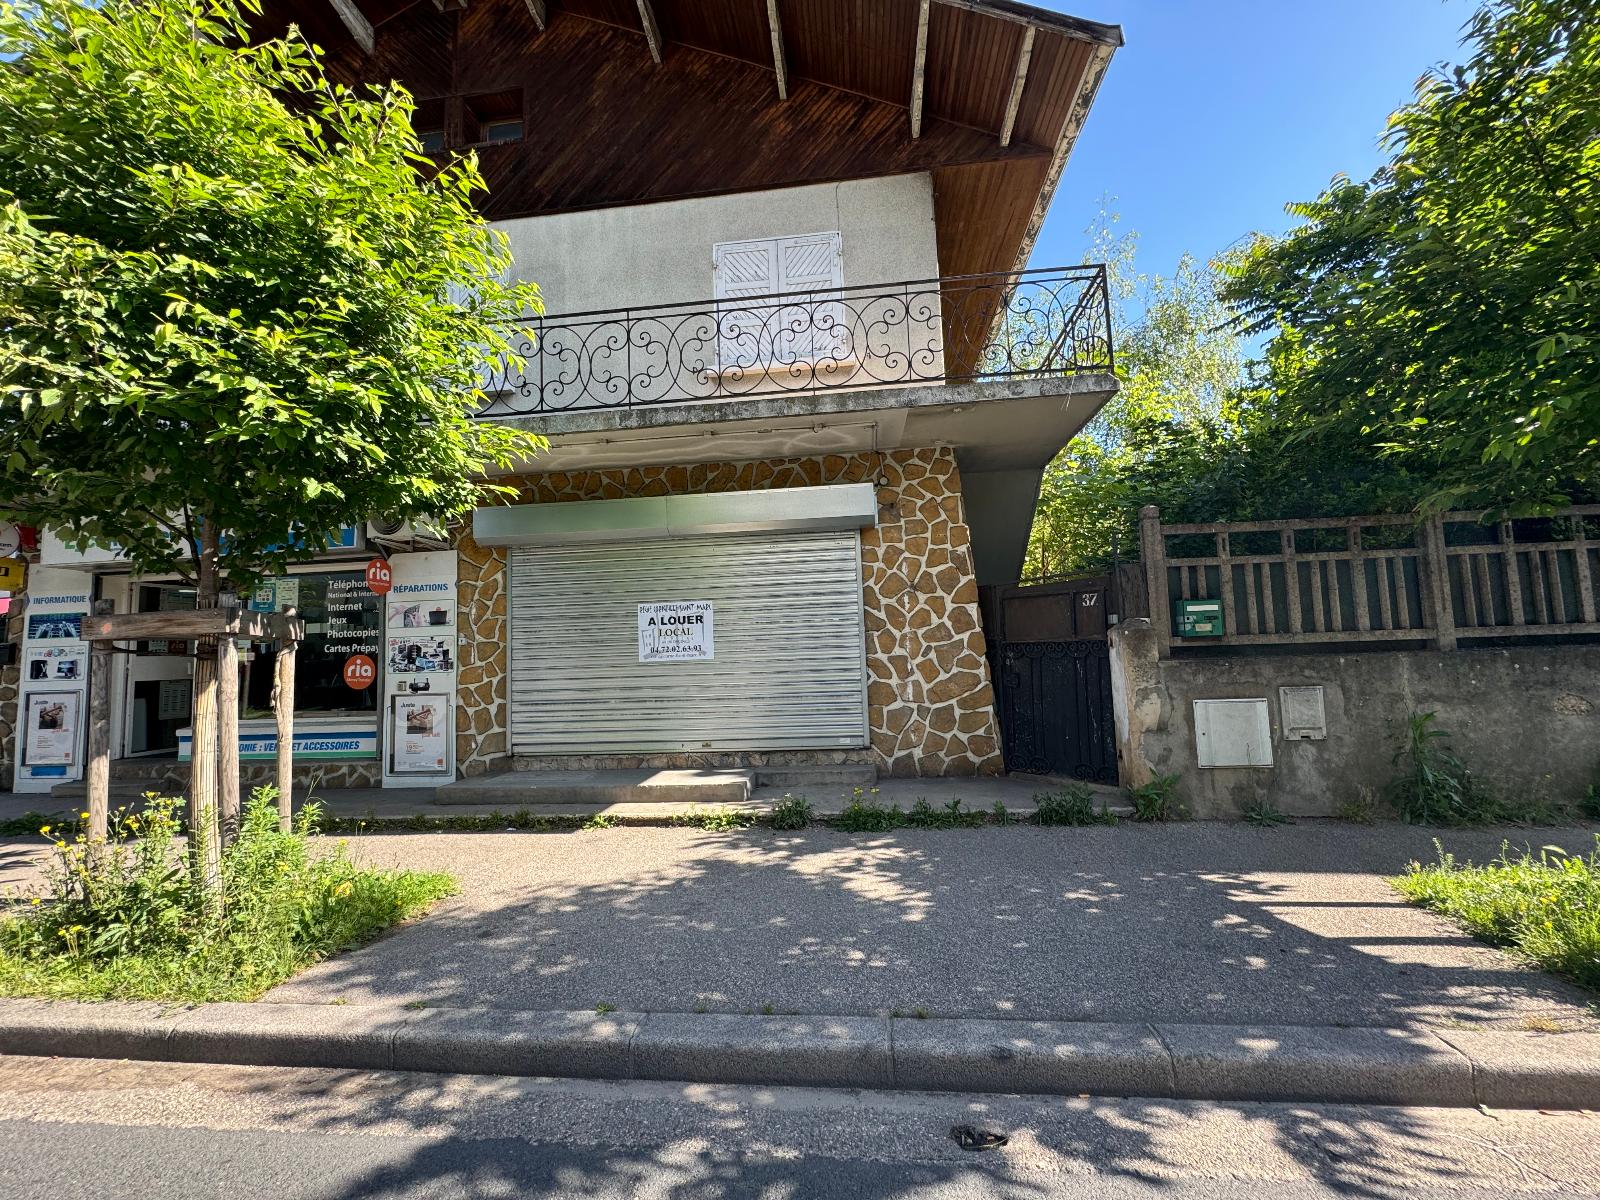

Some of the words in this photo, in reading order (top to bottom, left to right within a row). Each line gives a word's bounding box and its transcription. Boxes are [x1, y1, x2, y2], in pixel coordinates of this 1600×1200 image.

[370, 562, 389, 581] ria
[328, 579, 368, 590] Téléphon
[394, 583, 448, 593] RÉPARATIONS
[33, 594, 87, 605] INFORMATIQUE
[1082, 593, 1097, 607] 37
[328, 602, 362, 611] Internet
[327, 616, 347, 624] Jeux
[648, 617, 656, 626] A
[660, 615, 704, 625] LOUER
[327, 628, 379, 638] Photocopies
[659, 628, 694, 637] LOCAL
[324, 644, 350, 653] Cartes
[352, 643, 379, 654] Prépay
[348, 659, 371, 677] ria
[292, 742, 302, 751] ET
[303, 741, 360, 750] ACCESSOIRES
